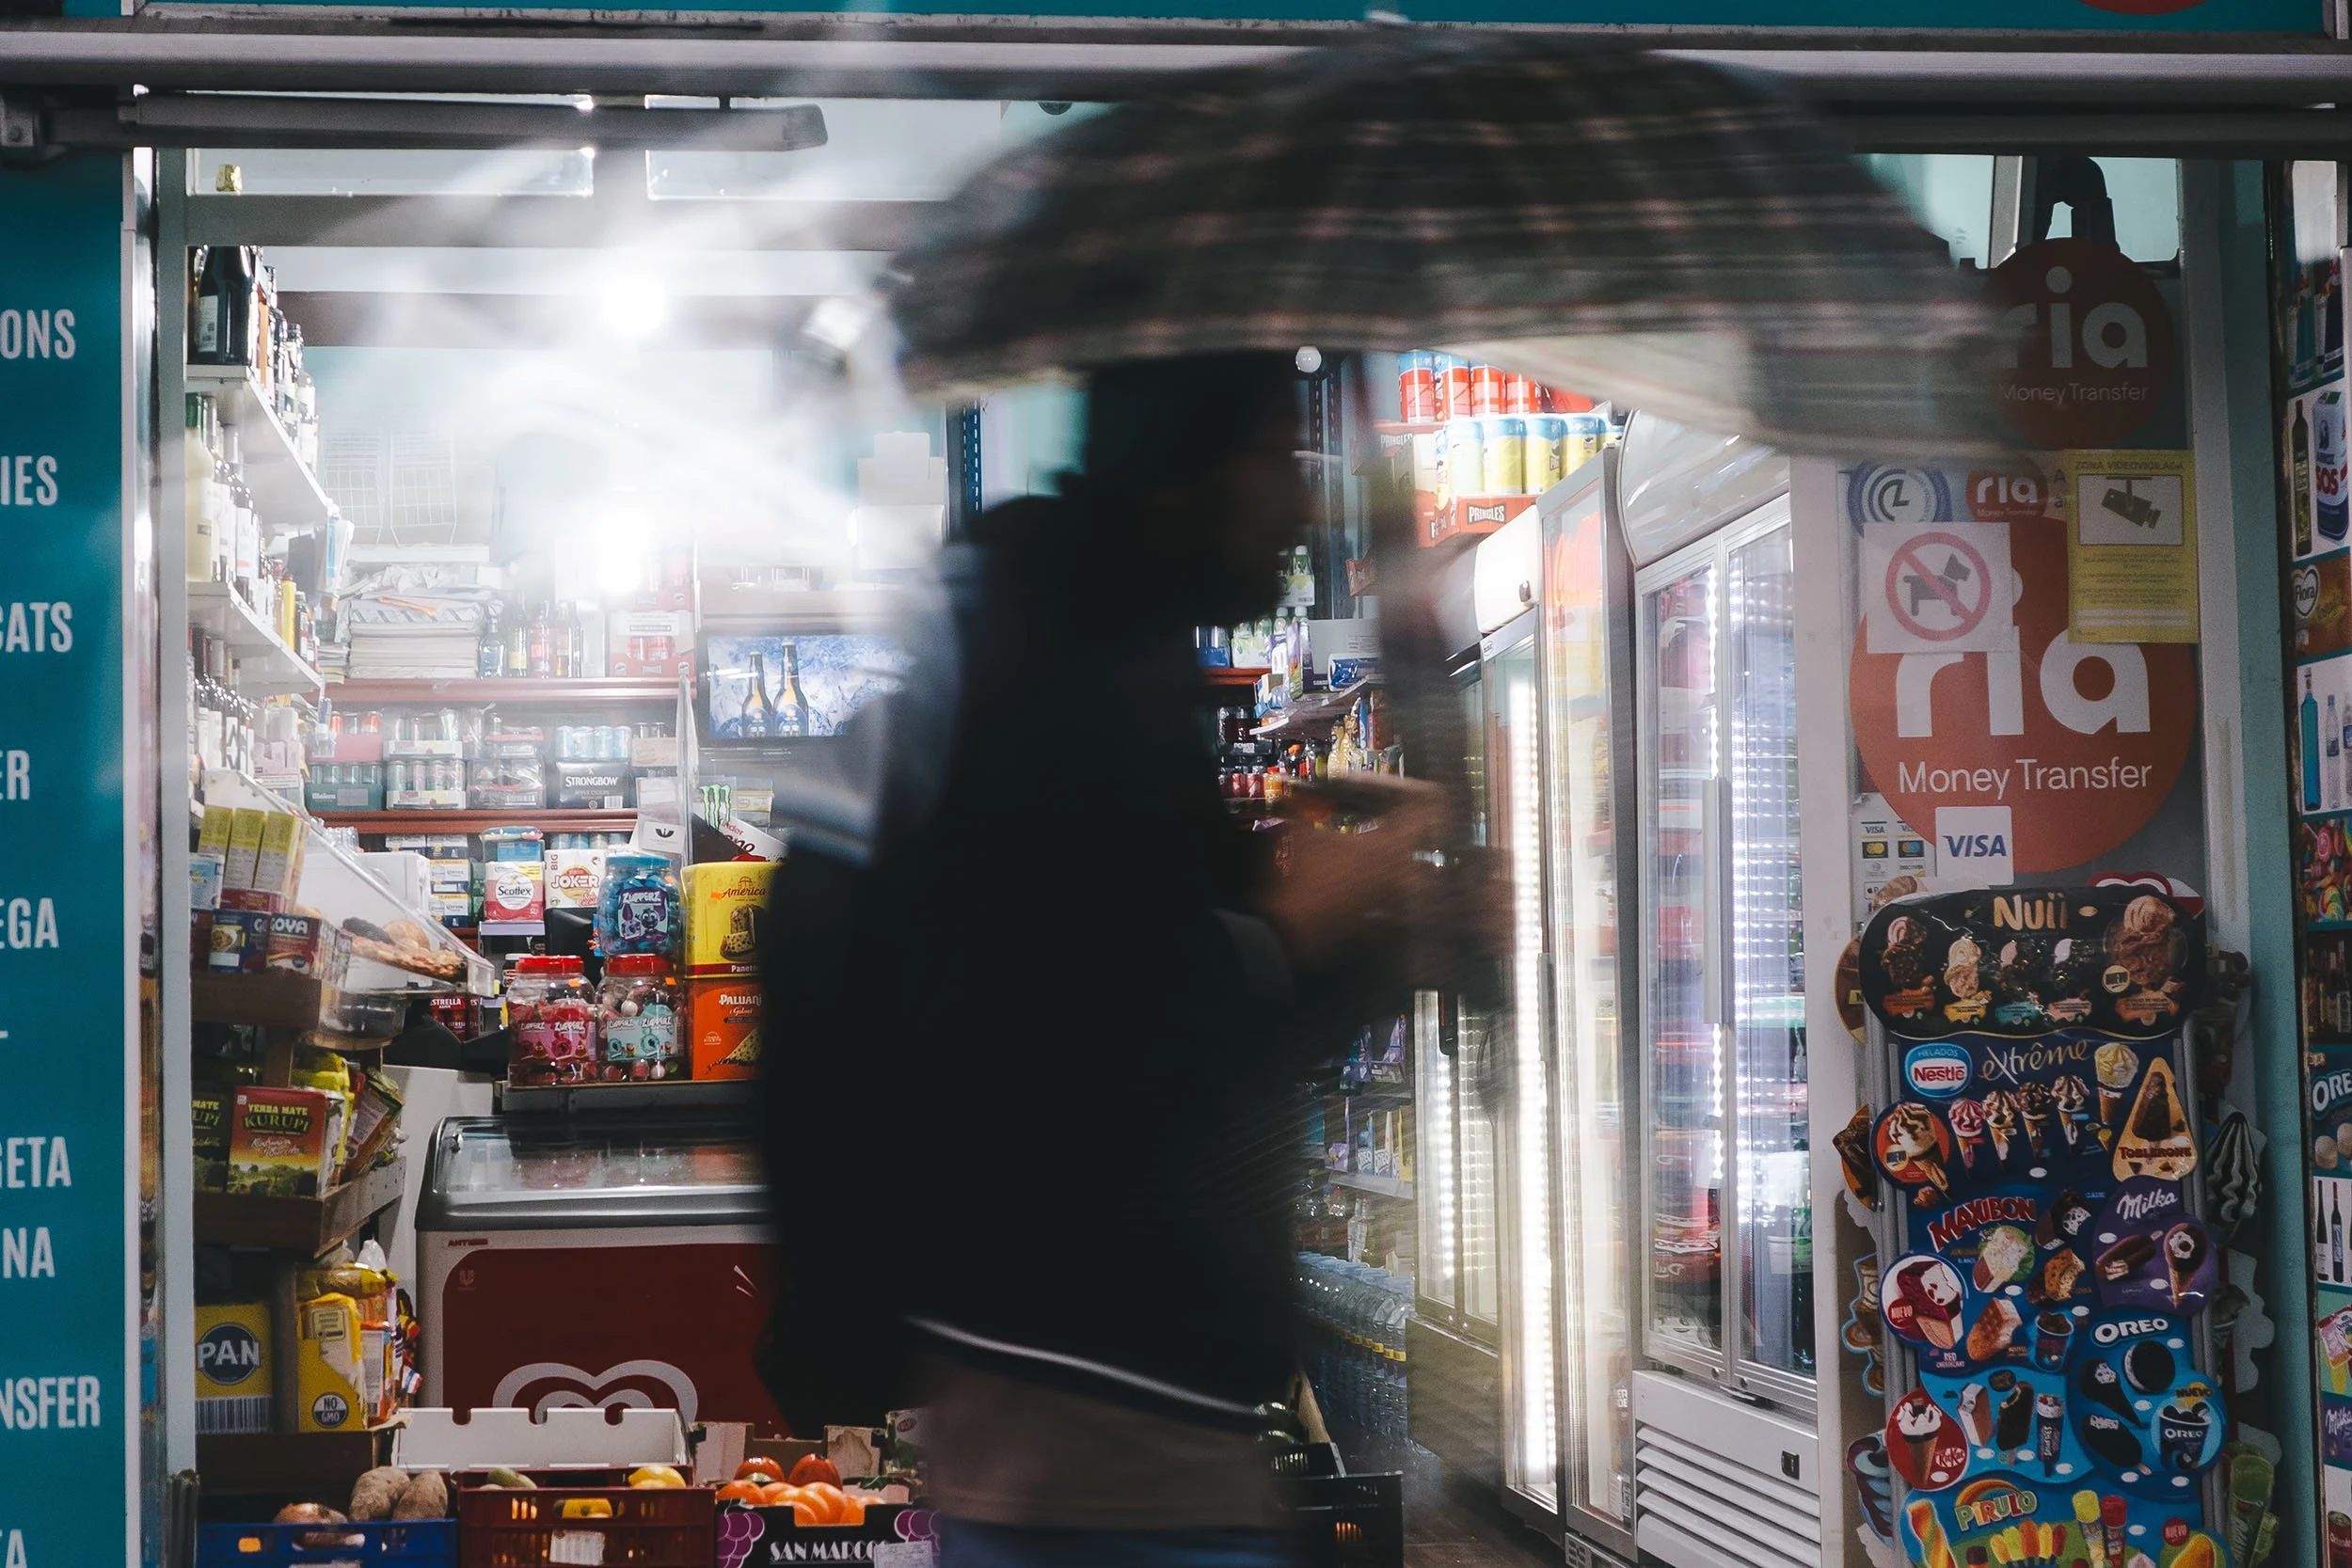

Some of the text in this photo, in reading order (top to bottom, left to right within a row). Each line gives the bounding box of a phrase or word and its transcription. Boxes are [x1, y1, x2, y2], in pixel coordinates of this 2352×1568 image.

[2000, 265, 2148, 369] ria
[2069, 381, 2150, 402] Transfer
[1469, 505, 1505, 524] PRINGLES
[0, 601, 73, 653] ATS
[1895, 628, 2151, 738] ria
[564, 776, 618, 787] STRONGBOW
[1899, 755, 2153, 800] Money Transfer
[1865, 826, 1885, 834] VISA
[1941, 833, 2008, 858] VISA
[498, 885, 532, 896] Scottex
[550, 875, 600, 889] JOKER
[1917, 1048, 1959, 1058] HELADOS
[1913, 1066, 1967, 1082] Nestlé
[247, 1103, 309, 1117] YERBA MATE
[0, 1136, 72, 1188] ETA
[2119, 1147, 2192, 1160] TOBLERONE
[2117, 1188, 2180, 1220] Milka
[1927, 1196, 2038, 1253] MAXIBON
[1890, 1305, 1913, 1319] NUEVO
[2094, 1317, 2169, 1344] OREO
[197, 1339, 261, 1368] PAN
[2175, 1387, 2212, 1399] NUEVO
[323, 1397, 338, 1411] NO
[321, 1411, 340, 1423] GMO
[2163, 1428, 2203, 1439] OREO
[1955, 1490, 2038, 1532] PIRULO
[771, 1541, 806, 1561] SAN
